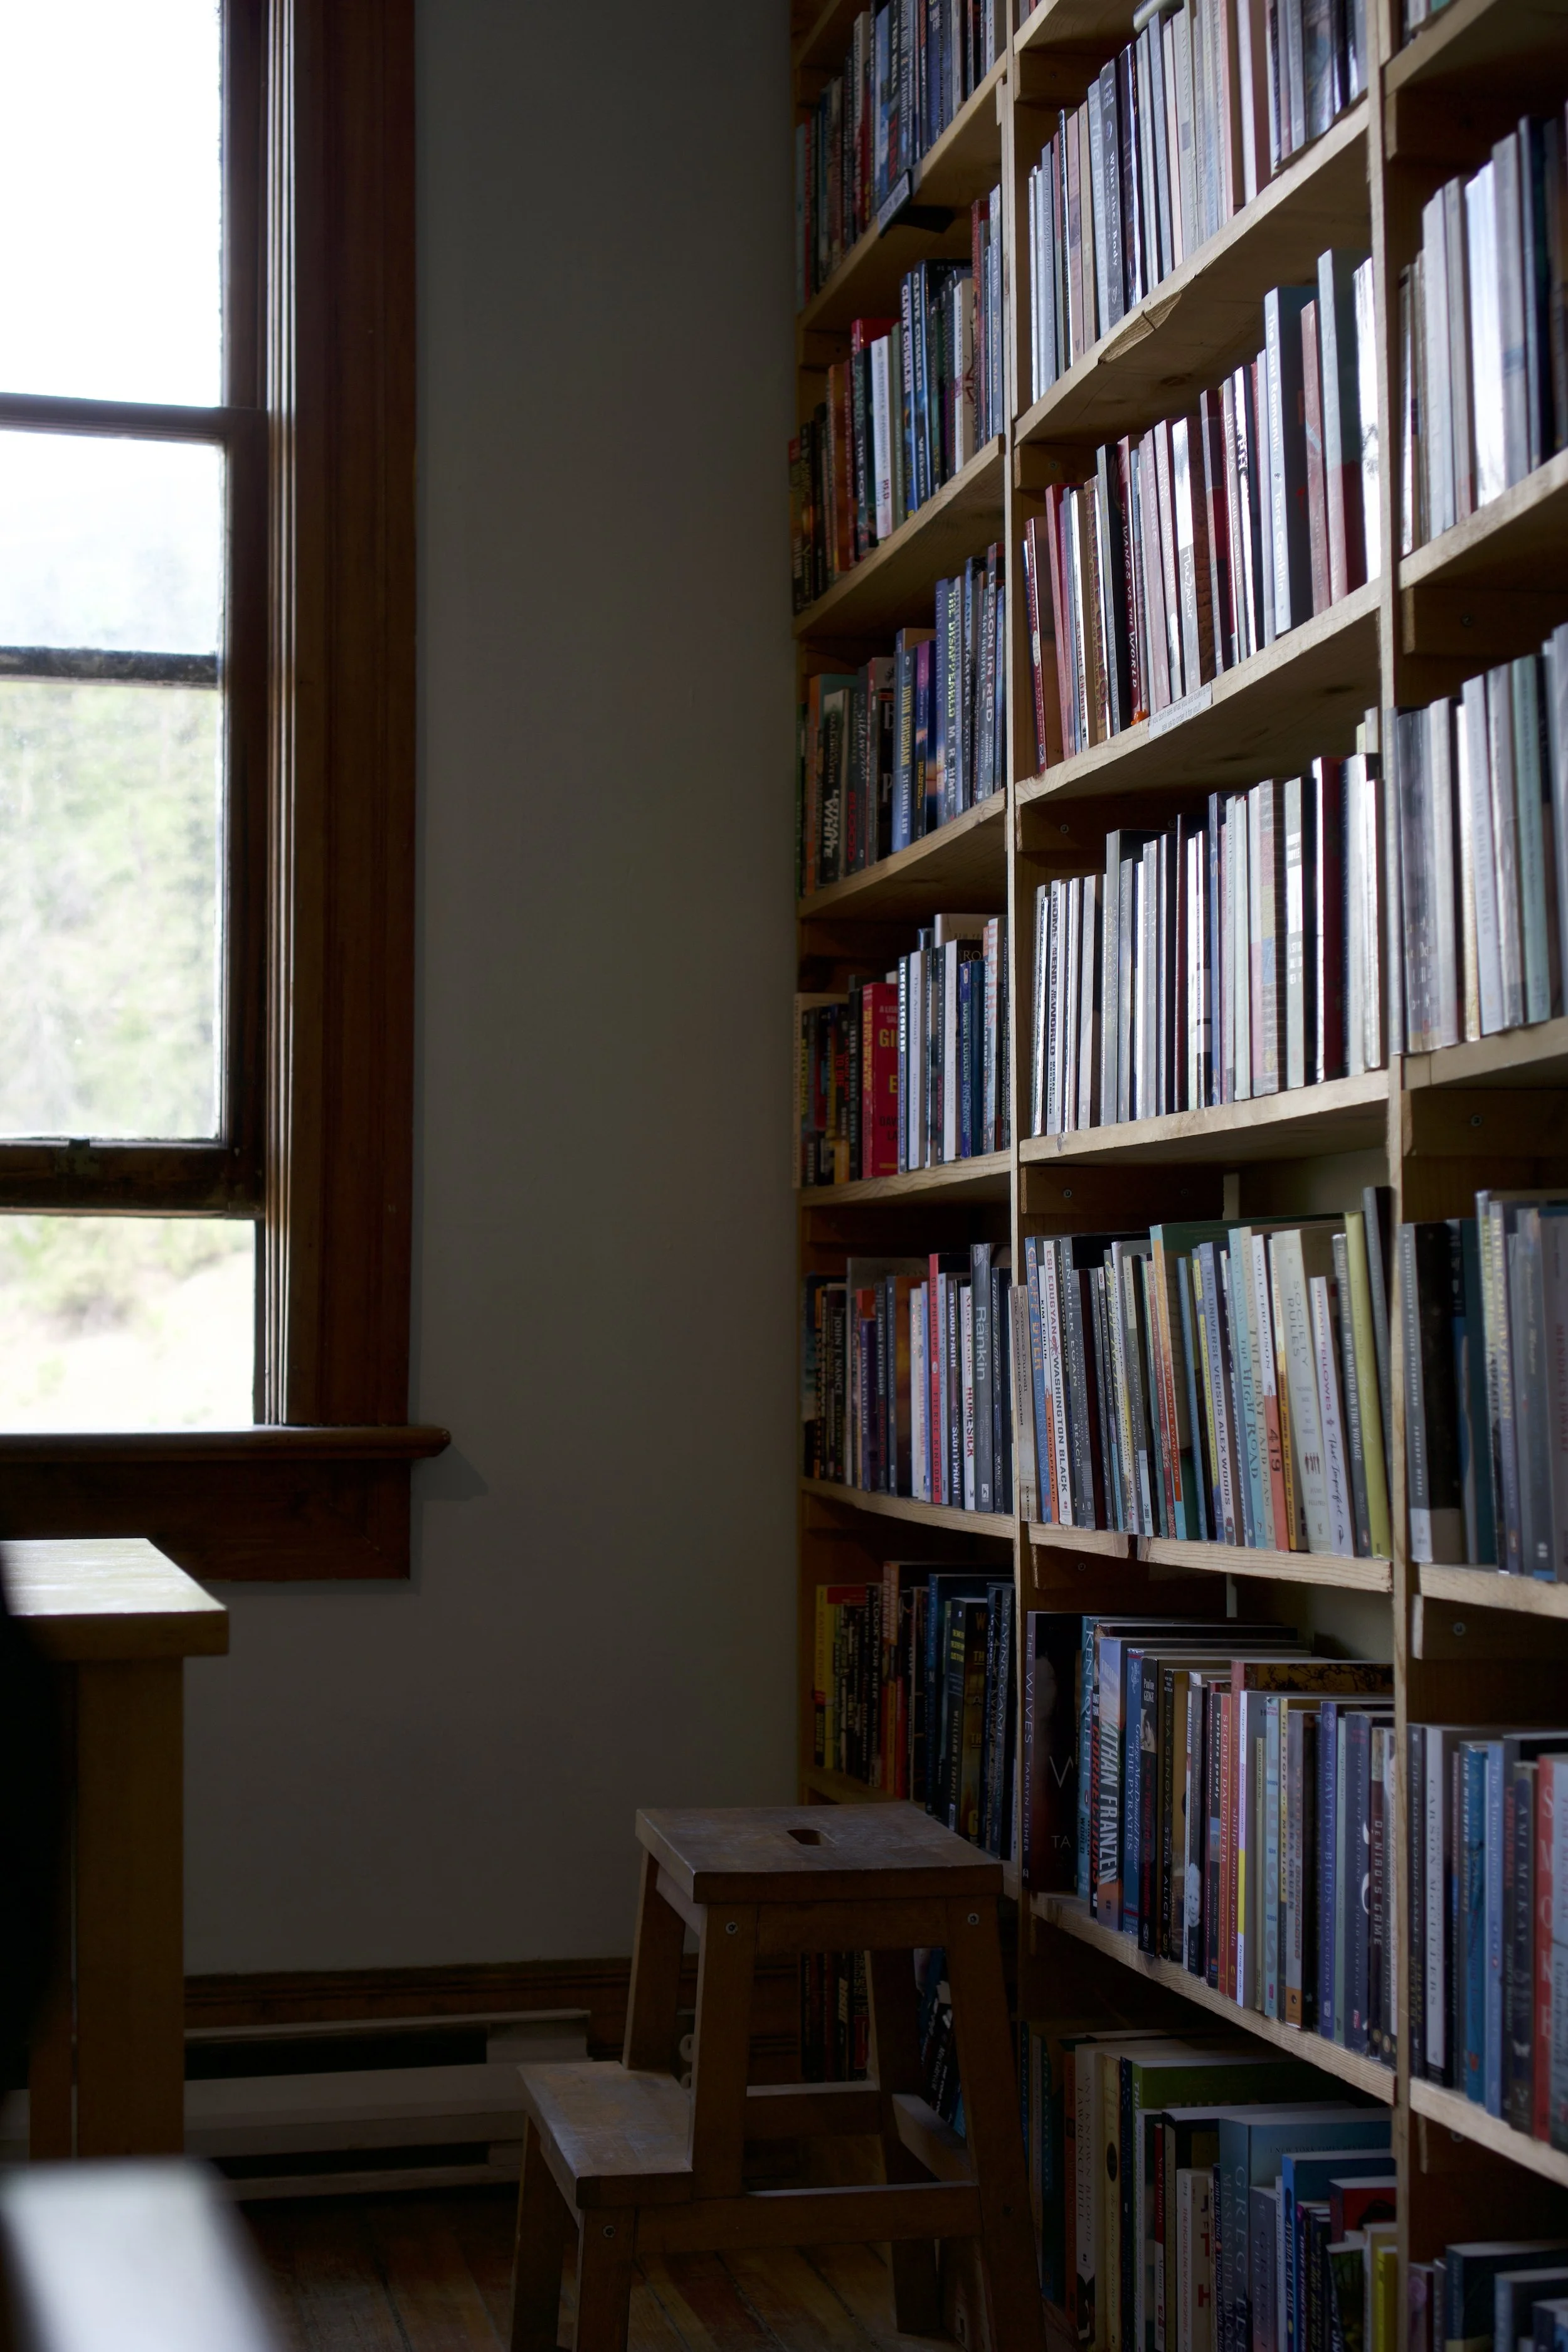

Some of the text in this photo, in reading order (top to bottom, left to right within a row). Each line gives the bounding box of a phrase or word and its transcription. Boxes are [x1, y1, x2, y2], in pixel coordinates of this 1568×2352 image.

[1093, 119, 1108, 307] The Boat People
[1268, 314, 1276, 342] The
[1226, 413, 1236, 474] BRIDA
[1234, 533, 1242, 586] COELHO
[1122, 525, 1131, 580] WANGS
[1276, 531, 1286, 592] Conklin
[936, 590, 944, 629] JOHN
[987, 570, 995, 648] LESSON
[987, 655, 993, 675] IN
[901, 684, 912, 767] JOHN GRISHAM
[824, 798, 834, 858] WHITE
[847, 791, 857, 862] BLOOD
[962, 1002, 970, 1082] ROBERT LUDLUM
[1027, 1246, 1042, 1371] GEOFF DYER
[1058, 1255, 1066, 1331] HALF-BLOOD
[1065, 1247, 1074, 1333] JENNIFER
[1293, 1280, 1308, 1368] SOCIETY
[834, 1315, 844, 1395] JOHN NANCE
[976, 1306, 987, 1381] Rankin
[1208, 1298, 1219, 1360] UNIVERSE
[1249, 1327, 1261, 1369] THE
[1287, 1298, 1300, 1358] RULES
[1047, 1276, 1057, 1335] EDUGYAN
[1053, 1356, 1065, 1444] WASHINGTON
[1059, 1449, 1067, 1493] BLACK
[1104, 1348, 1113, 1407] ISLAND
[1214, 1365, 1224, 1416] VERSUS
[1241, 1338, 1259, 1480] THE HIGH ROAD
[1256, 1379, 1264, 1421] BEST
[1259, 1294, 1271, 1370] FERGUSON
[1269, 1428, 1281, 1473] 419
[1345, 1333, 1362, 1462] NOT WANTED ON THE VOYAGE
[1165, 1360, 1179, 1484] STEPHANIE EVANOVICH
[1218, 1421, 1227, 1453] ALEX
[1258, 1426, 1268, 1466] LAID
[1321, 1341, 1344, 1519] FELLOWES Past Imperfect
[1047, 1436, 1056, 1503] DISAPPEARED
[1222, 1458, 1231, 1506] WOODS
[997, 1623, 1009, 1744] LYING GAME
[1085, 1629, 1094, 1676] KEN
[1025, 1671, 1034, 1744] WIVES
[1163, 1704, 1172, 1740] LISA
[950, 1765, 958, 1801] TAPPLY
[1099, 1681, 1119, 1886] JONATHAN FRANZEN
[1126, 1742, 1135, 1851] THE PYRATES
[1133, 1722, 1143, 1873] George MacDonald Fraser
[1324, 1760, 1333, 1831] GRAVITY
[1357, 1806, 1362, 1821] OF
[1518, 1801, 1528, 1848] AMI
[1162, 1872, 1170, 1921] ALICE
[1229, 1806, 1239, 1947] shilpi somaya gowda
[1324, 1850, 1333, 1905] BIRDS
[1374, 1841, 1383, 1946] NIRO'S GAME
[1084, 2072, 1093, 2243] ANY KNOWN BLOOD
[1223, 2172, 1234, 2291] MISSISSIPPI
[1235, 2164, 1247, 2275] GREG
[1285, 2219, 1293, 2264] AYESHA
[1217, 2291, 1223, 2302] TO
[1286, 2268, 1293, 2285] AT
